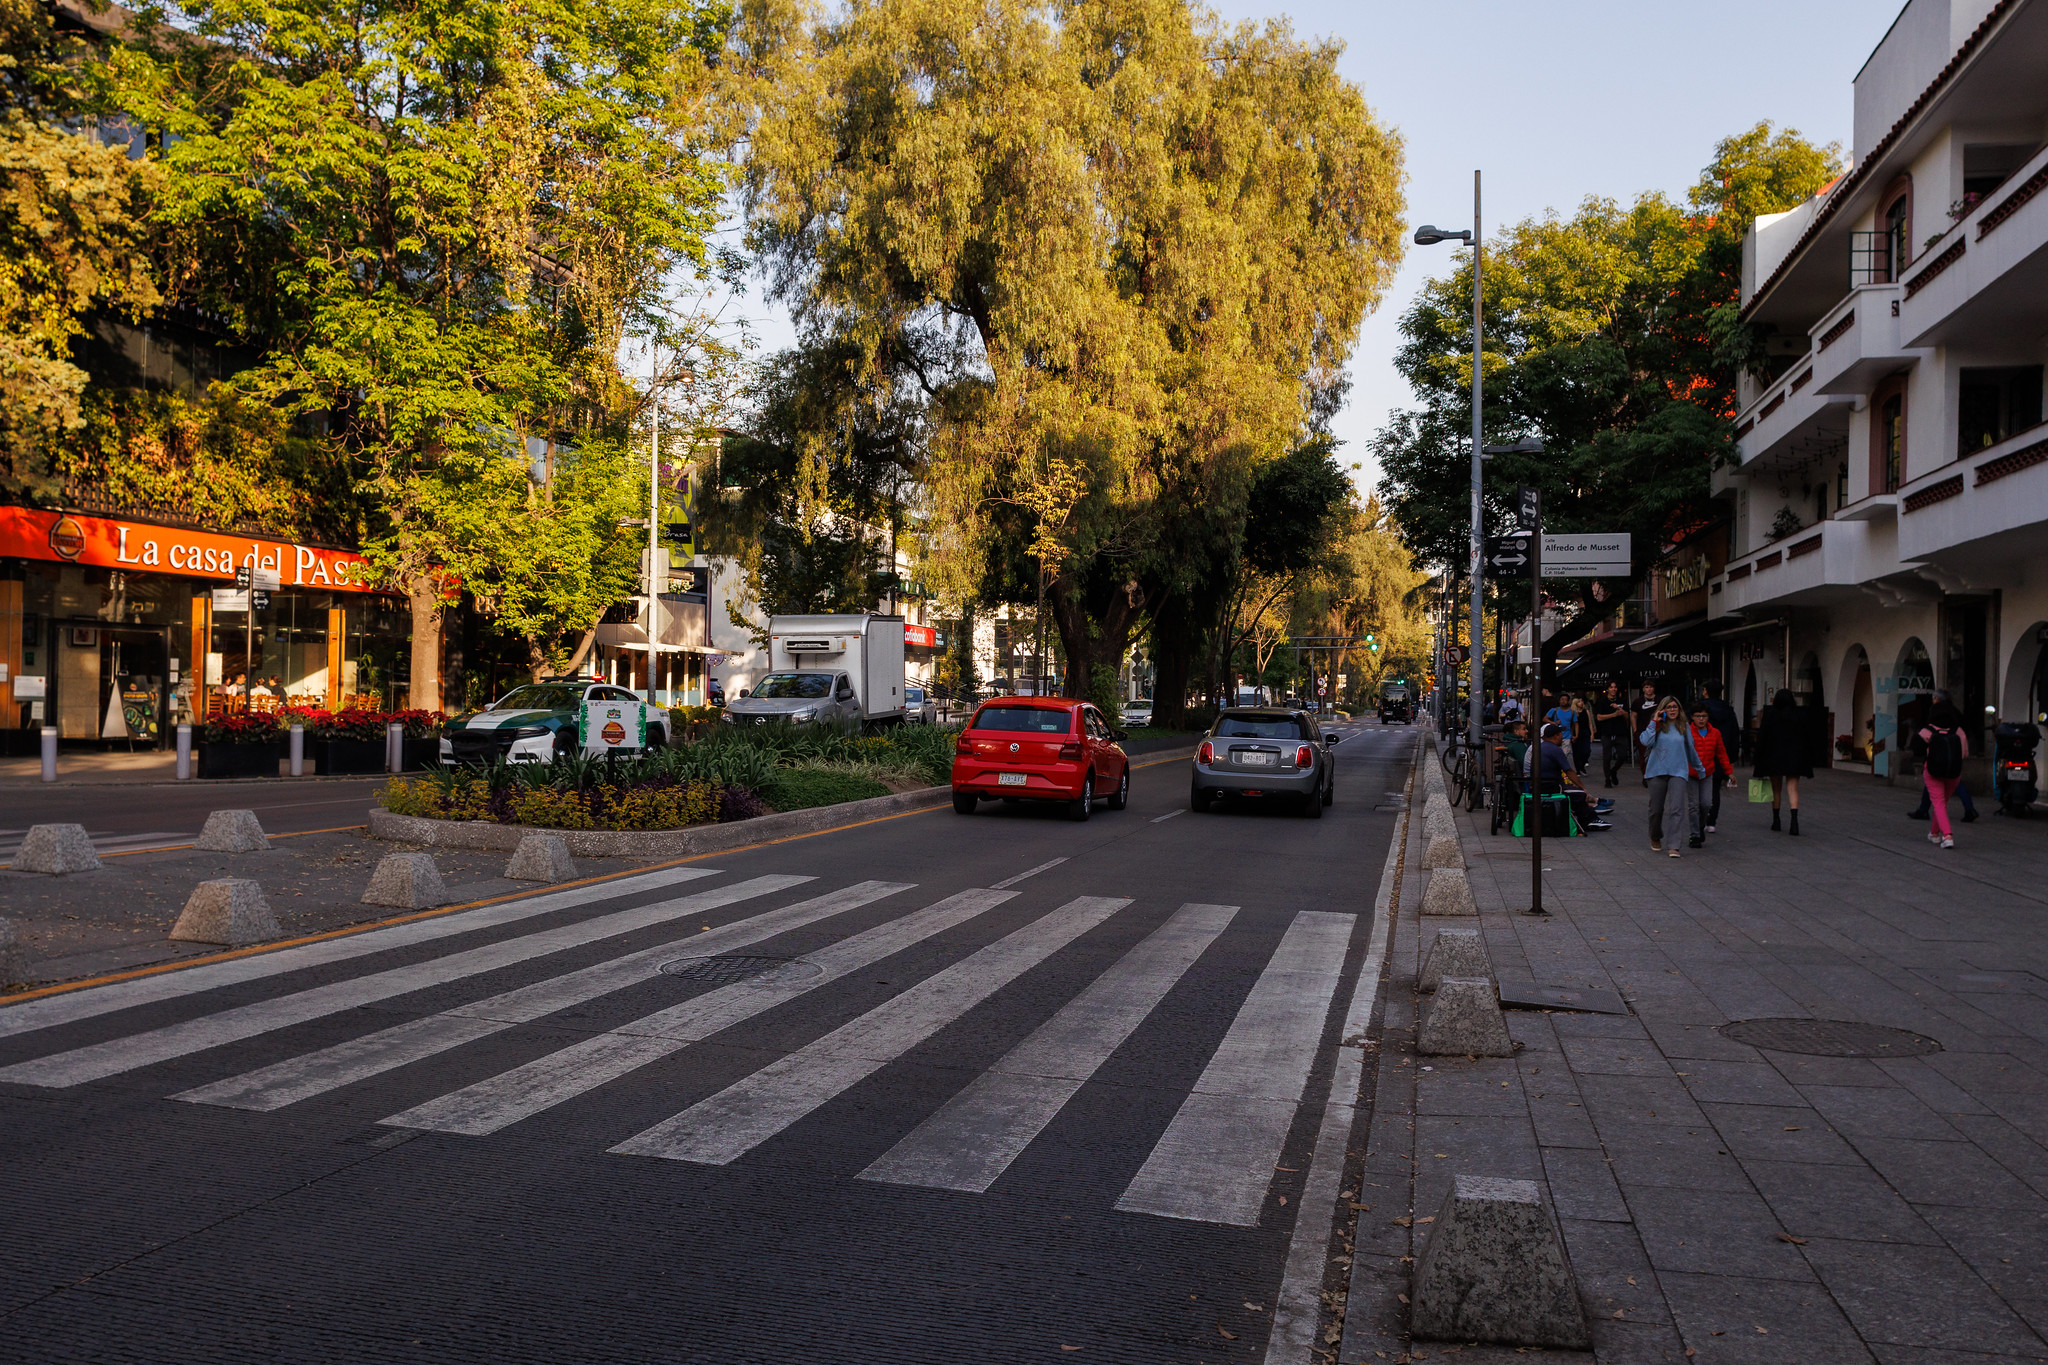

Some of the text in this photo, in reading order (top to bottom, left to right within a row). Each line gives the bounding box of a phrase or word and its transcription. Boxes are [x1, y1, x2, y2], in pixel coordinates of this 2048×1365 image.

[1545, 544, 1575, 552] Alfredo
[116, 526, 399, 593] La casa del PASTO
[905, 628, 925, 643] cotiabank
